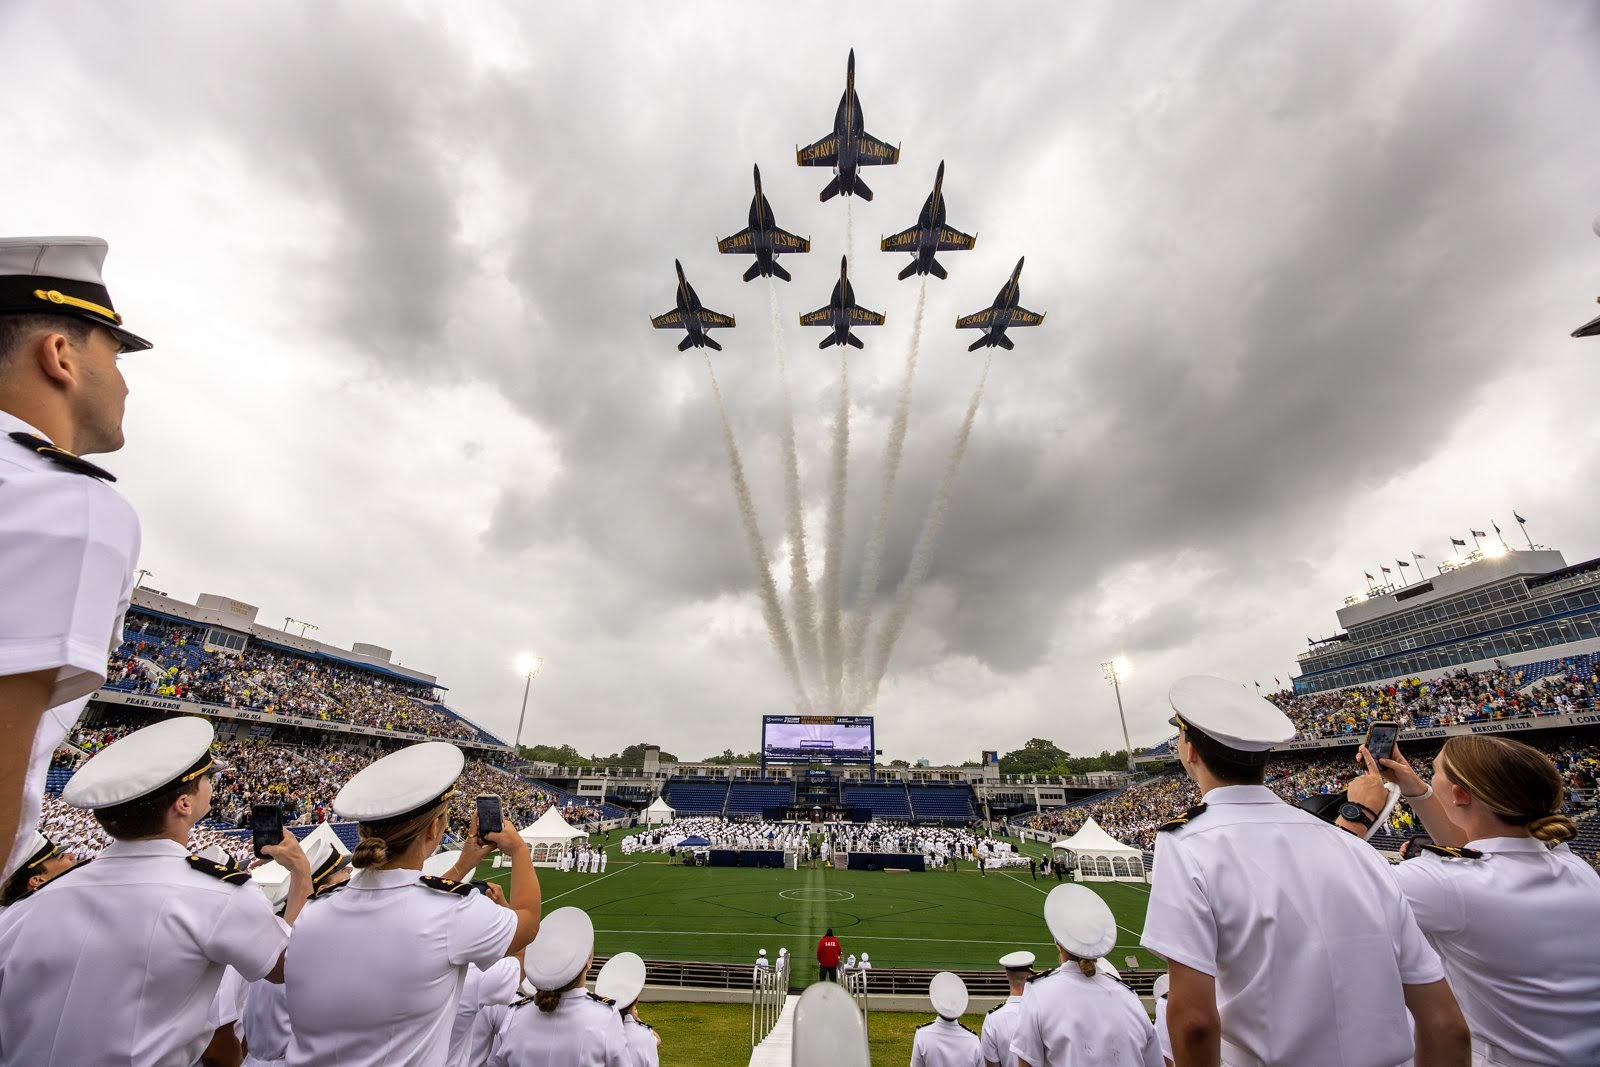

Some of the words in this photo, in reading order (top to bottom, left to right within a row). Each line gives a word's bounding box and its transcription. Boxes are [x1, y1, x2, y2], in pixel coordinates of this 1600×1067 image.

[125, 697, 150, 706] PEARL
[151, 701, 181, 710] HARBOR
[201, 707, 219, 715] WAKE
[1471, 723, 1503, 733] MEKONG
[1506, 721, 1532, 730] DELTA
